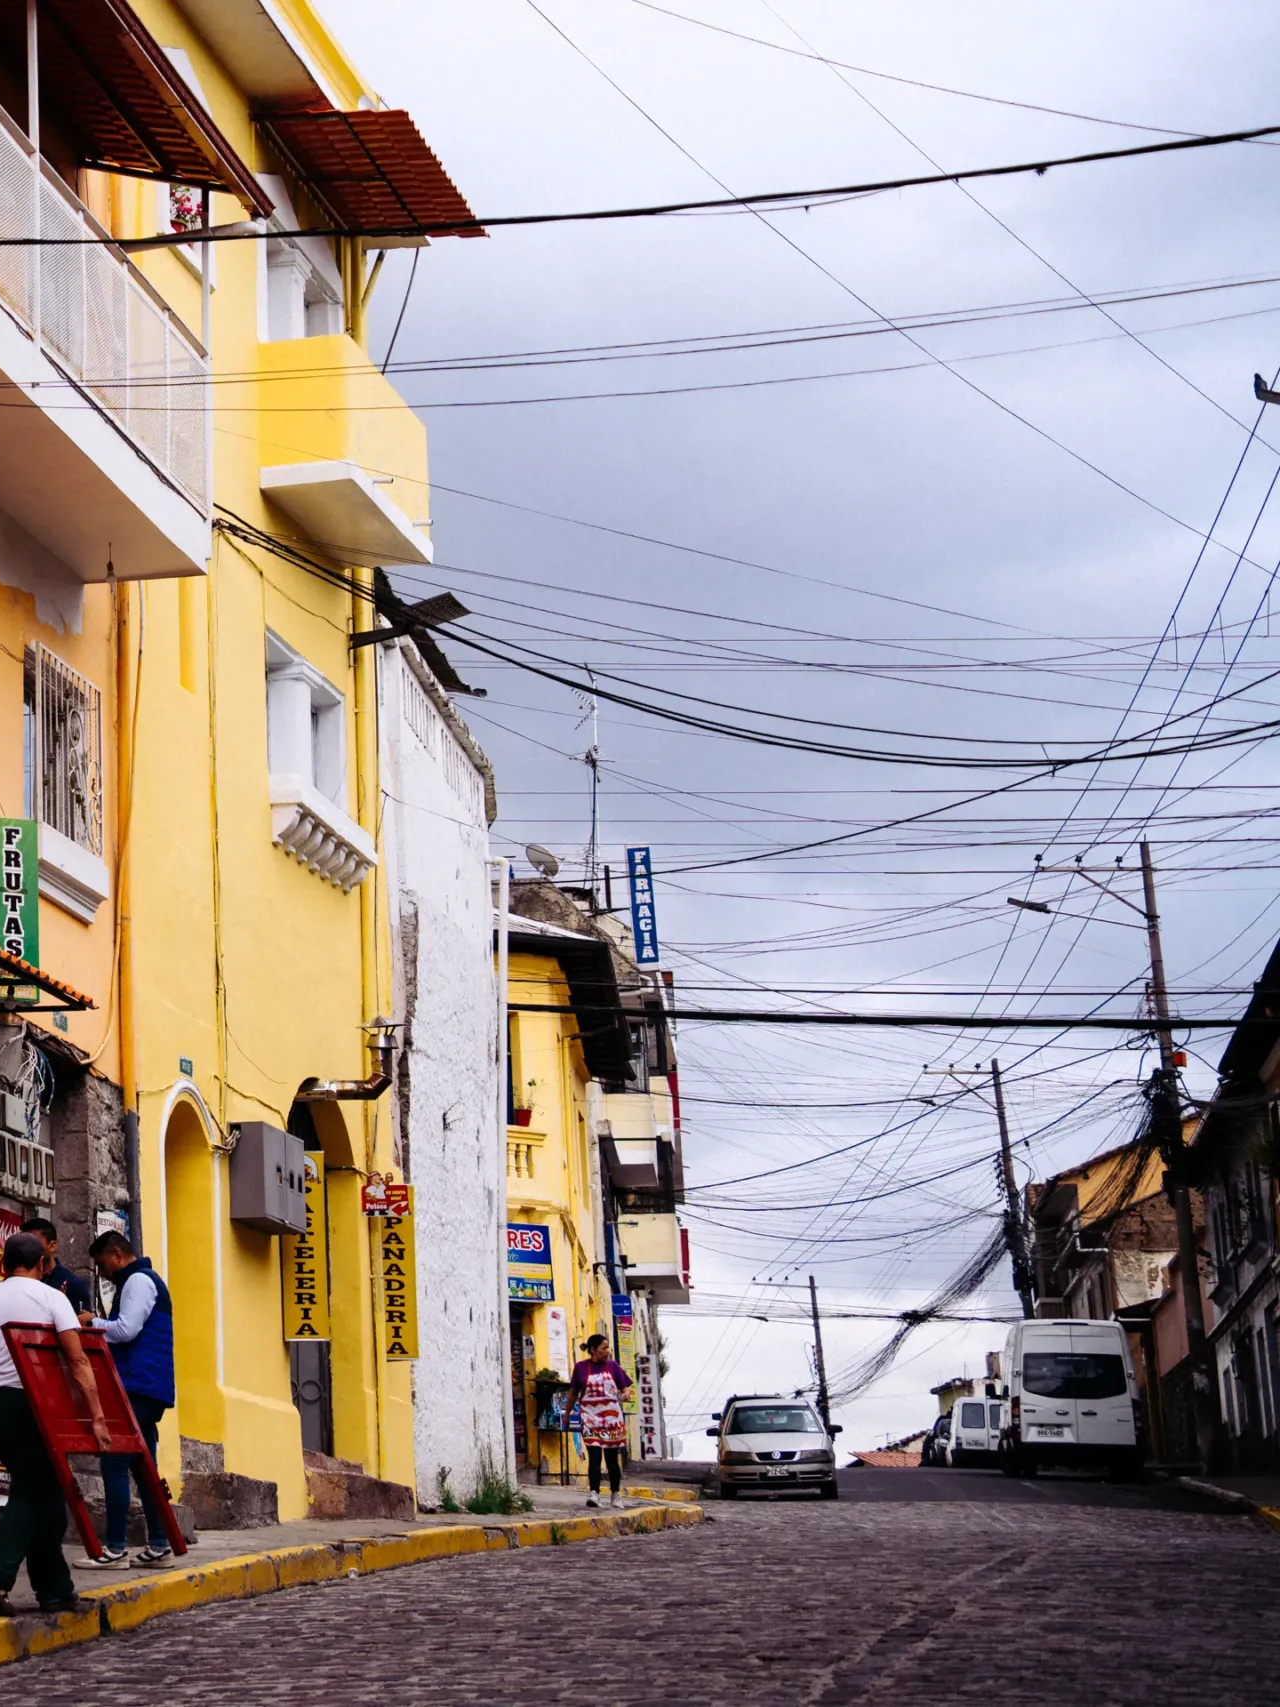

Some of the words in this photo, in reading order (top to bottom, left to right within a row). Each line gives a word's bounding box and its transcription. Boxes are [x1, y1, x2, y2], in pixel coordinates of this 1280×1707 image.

[3, 827, 24, 959] FRUTAS
[634, 851, 656, 958] FARMACIA
[382, 1216, 409, 1355] PANADERIA
